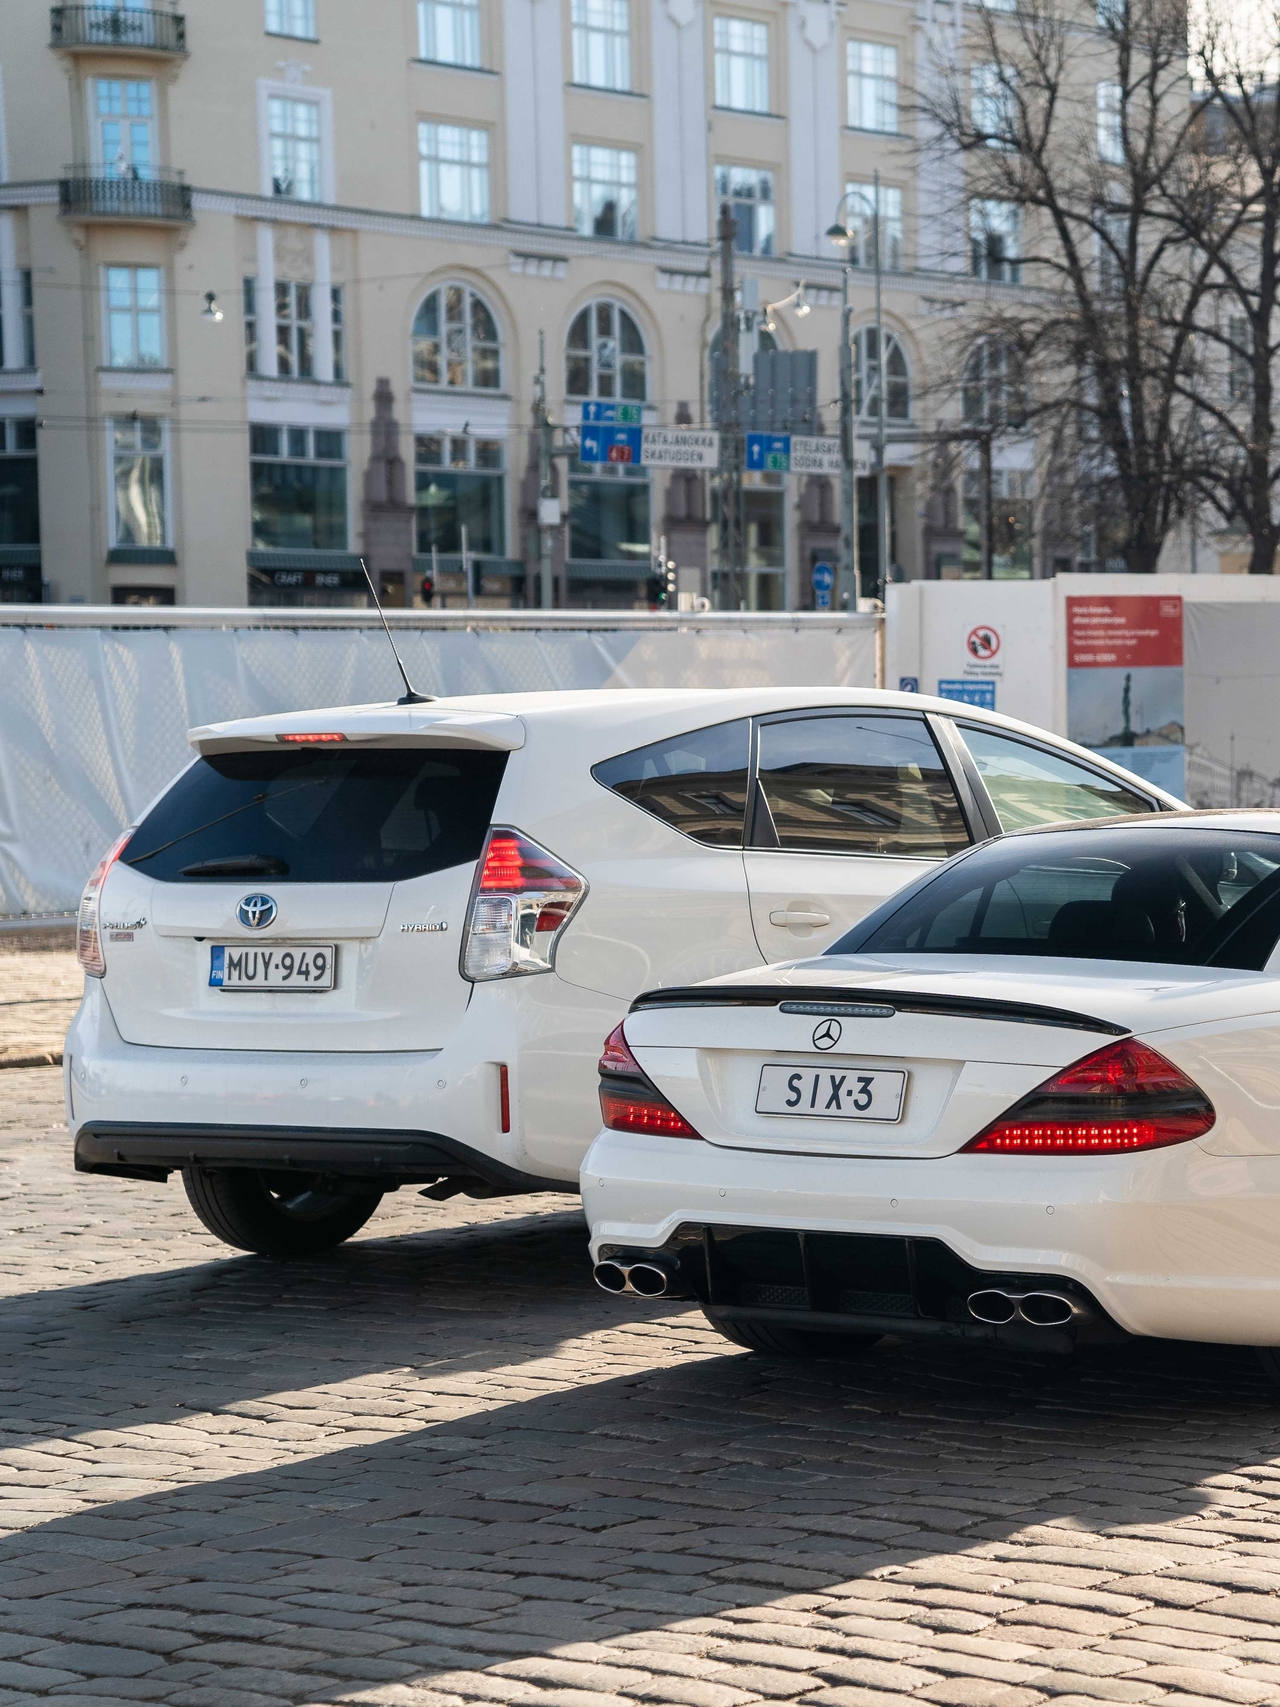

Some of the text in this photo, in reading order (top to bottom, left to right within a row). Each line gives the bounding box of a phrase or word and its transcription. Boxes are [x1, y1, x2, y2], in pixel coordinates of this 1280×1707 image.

[643, 431, 714, 448] KATAJANOKKA
[643, 448, 704, 463] SKATUDDEN
[400, 922, 439, 932] HYBRID
[211, 970, 223, 979] FIN
